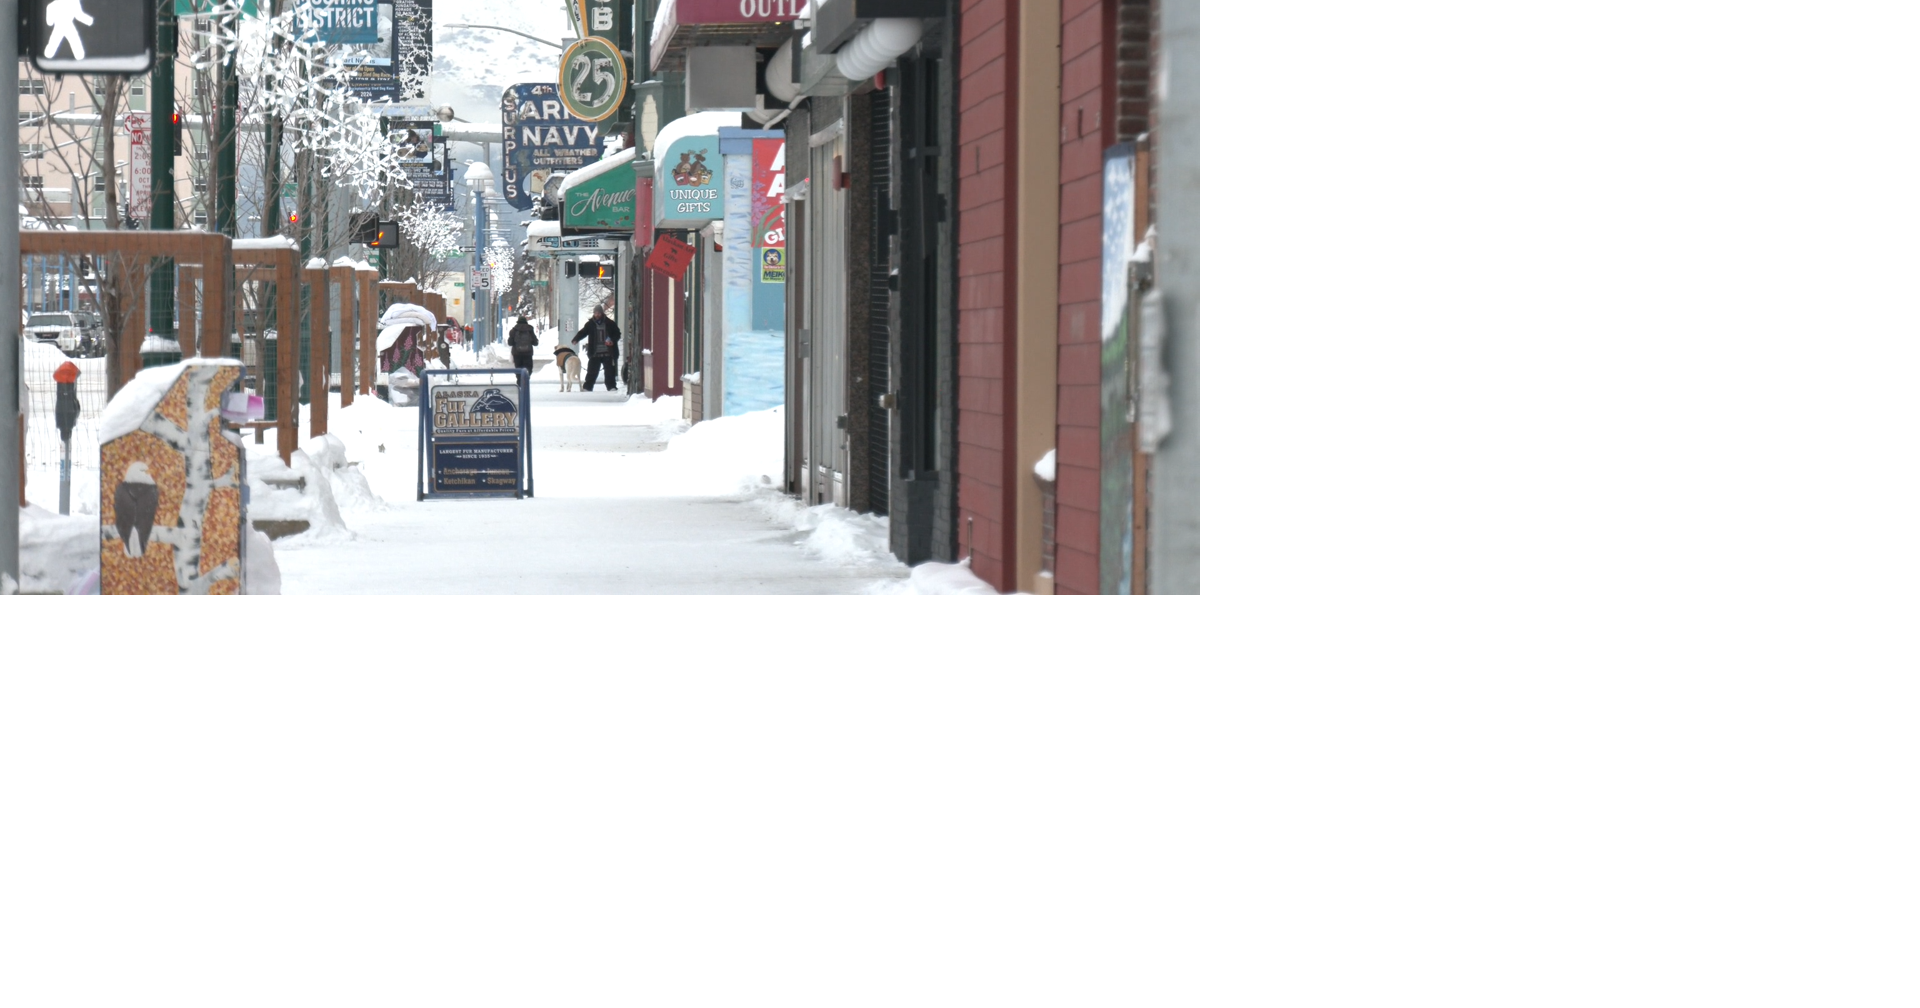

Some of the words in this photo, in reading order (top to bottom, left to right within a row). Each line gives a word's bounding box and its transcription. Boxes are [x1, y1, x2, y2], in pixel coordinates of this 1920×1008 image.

[740, 0, 801, 18] OUTL
[296, 7, 375, 28] DISTRICT
[571, 54, 615, 108] 25
[520, 100, 577, 120] AR
[131, 131, 142, 143] NO
[522, 125, 598, 146] NAVY
[503, 97, 518, 198] SURPLUS
[533, 148, 551, 157] ALL
[554, 148, 597, 157] WEATHER
[533, 156, 583, 165] OUTFITTERS
[570, 188, 636, 217] Avenue
[669, 189, 718, 201] UNIQUE
[677, 202, 711, 213] GIFTS
[435, 390, 479, 398] ALASKA
[435, 398, 466, 413] Fur
[434, 412, 517, 428] GALLERY
[443, 467, 478, 476] Anchorage
[443, 477, 476, 485] Ketchikan
[487, 477, 516, 486] Skagway
